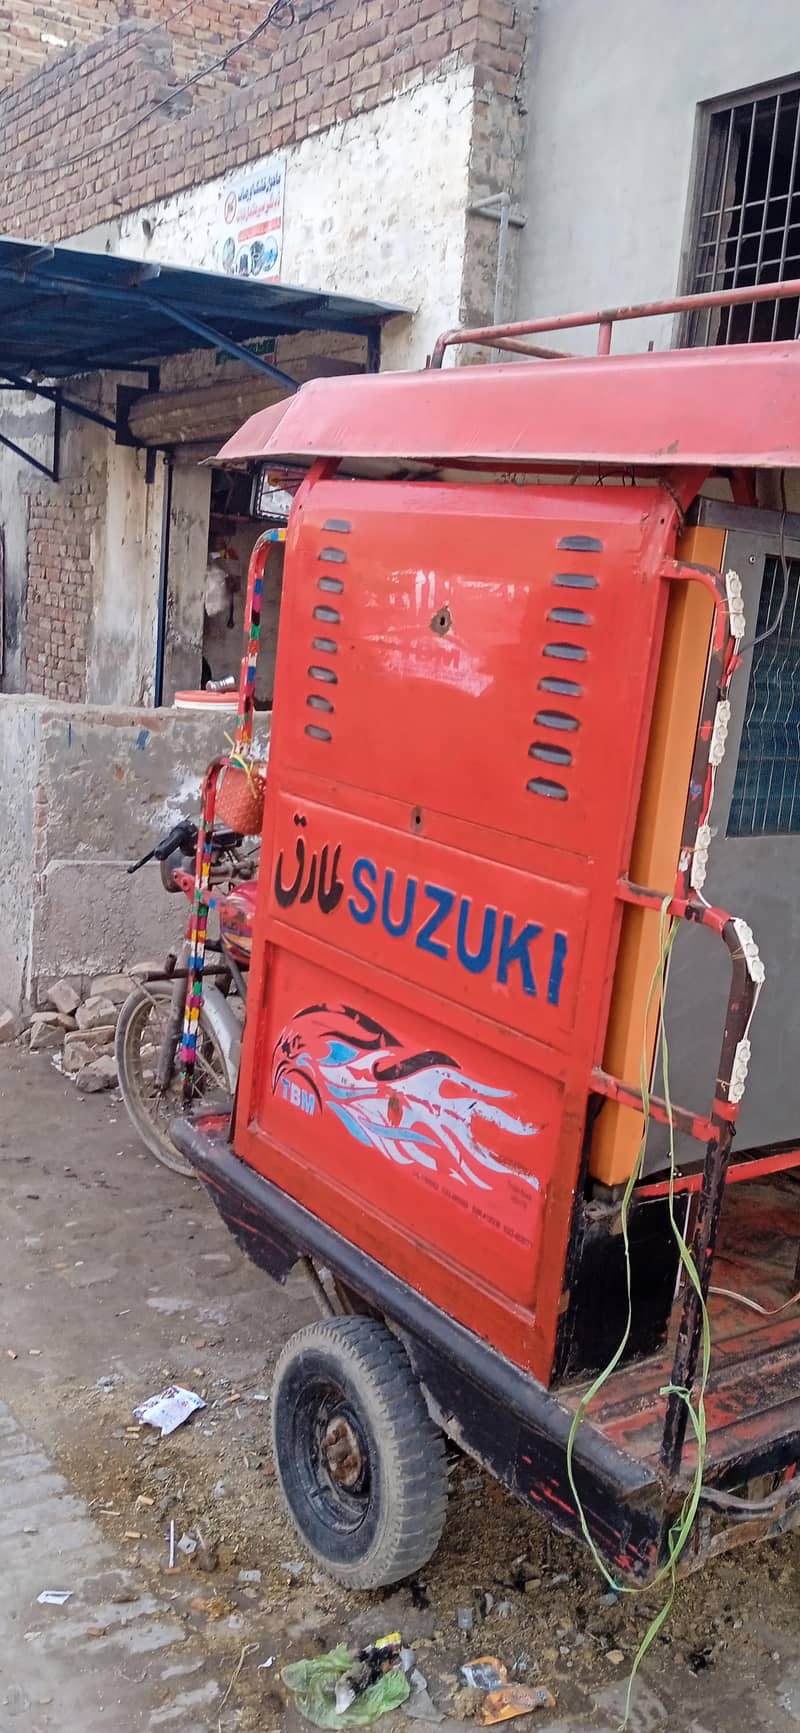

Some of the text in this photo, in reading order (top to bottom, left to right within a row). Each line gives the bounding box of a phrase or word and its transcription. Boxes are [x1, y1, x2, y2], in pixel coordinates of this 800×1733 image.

[275, 813, 344, 914] طارق
[348, 857, 567, 1006] SUZUKI
[282, 1079, 315, 1116] TBM
